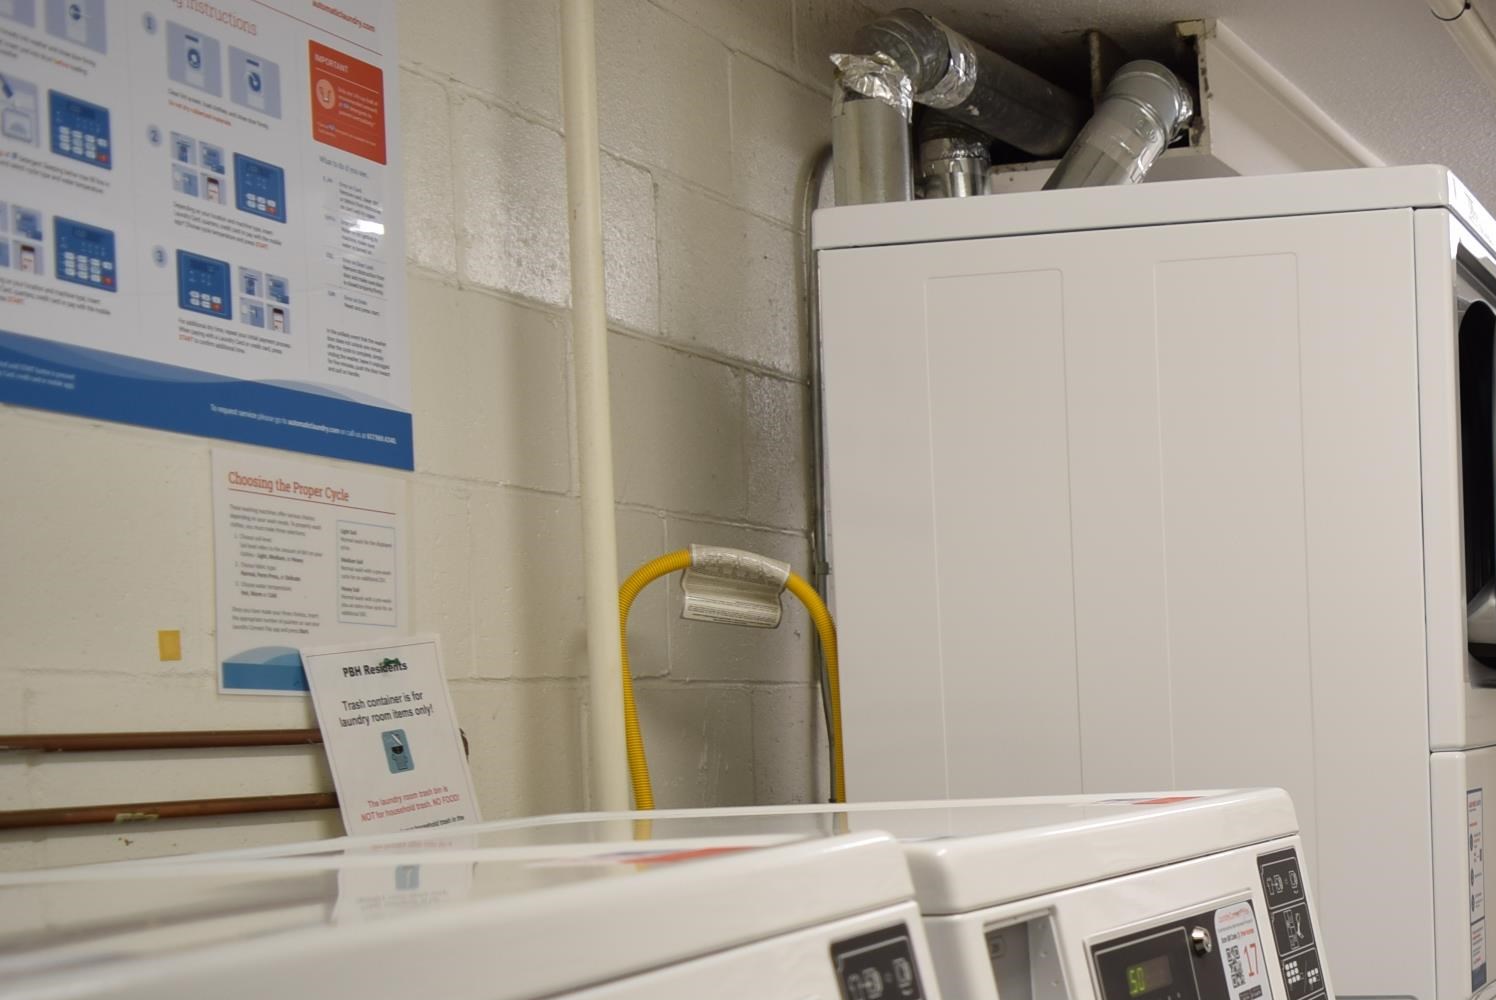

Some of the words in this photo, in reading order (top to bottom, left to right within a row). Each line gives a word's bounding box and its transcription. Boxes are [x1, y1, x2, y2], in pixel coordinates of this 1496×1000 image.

[228, 471, 273, 492] Choosing
[275, 479, 290, 492] the
[293, 481, 323, 498] Proper
[324, 486, 349, 502] Cycle
[342, 665, 362, 677] PBH
[363, 661, 408, 675] Residents
[341, 699, 366, 711] Trash
[367, 695, 402, 708] container
[404, 692, 411, 702] is
[412, 691, 423, 701] for
[339, 714, 369, 727] laundry
[371, 711, 392, 722] room
[392, 708, 414, 719] items
[415, 704, 434, 716] only!
[367, 800, 380, 808] The
[380, 795, 402, 806] laundry
[361, 811, 375, 822] NOT
[1243, 943, 1259, 977] 17
